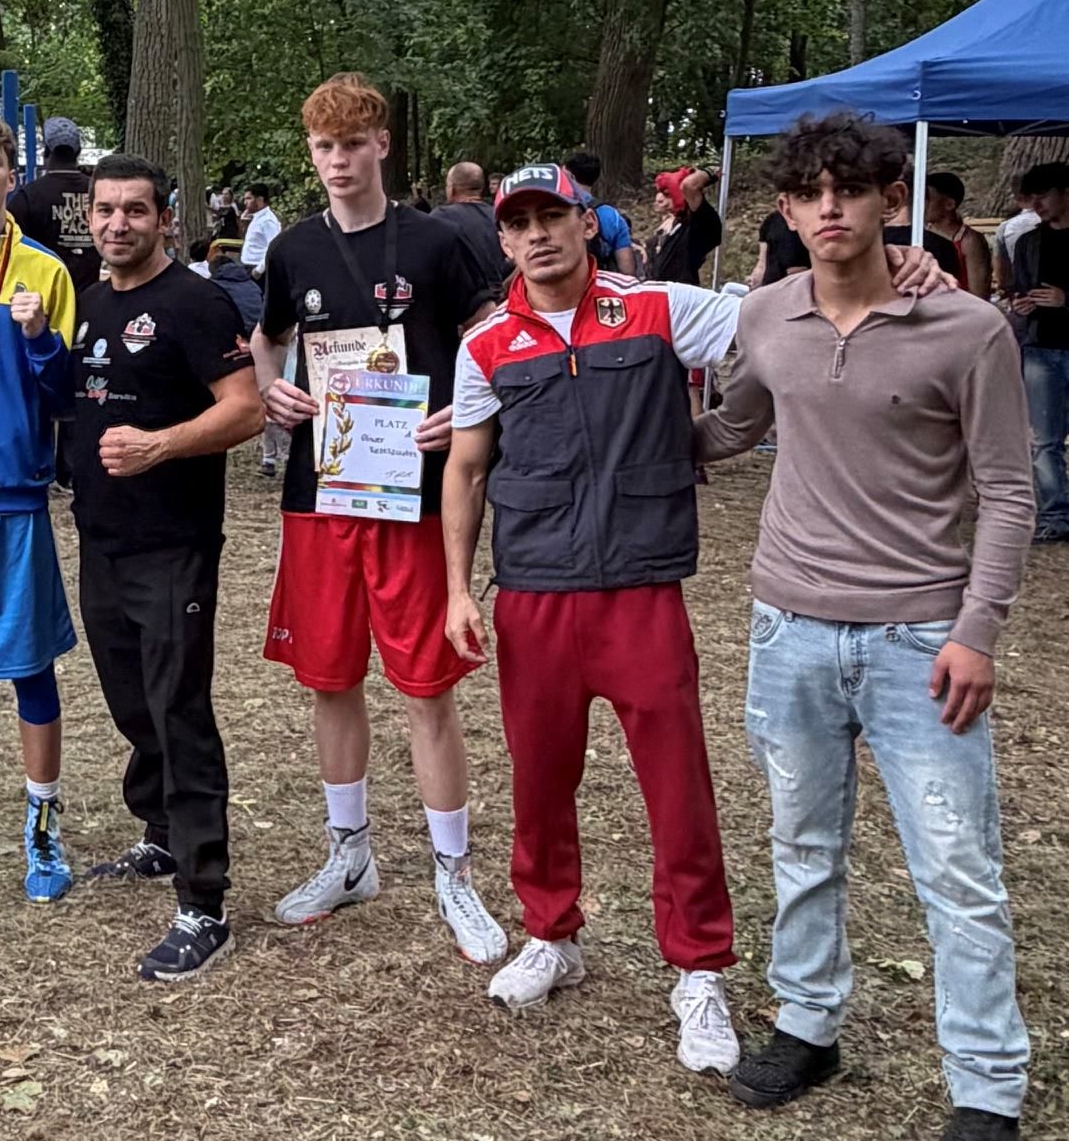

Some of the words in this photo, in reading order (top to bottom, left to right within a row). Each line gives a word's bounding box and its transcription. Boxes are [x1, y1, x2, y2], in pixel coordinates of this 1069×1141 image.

[505, 167, 554, 194] NETS
[62, 193, 90, 210] THE
[60, 220, 89, 234] FAC
[310, 340, 367, 360] Urkunde
[374, 418, 408, 430] PLATZ
